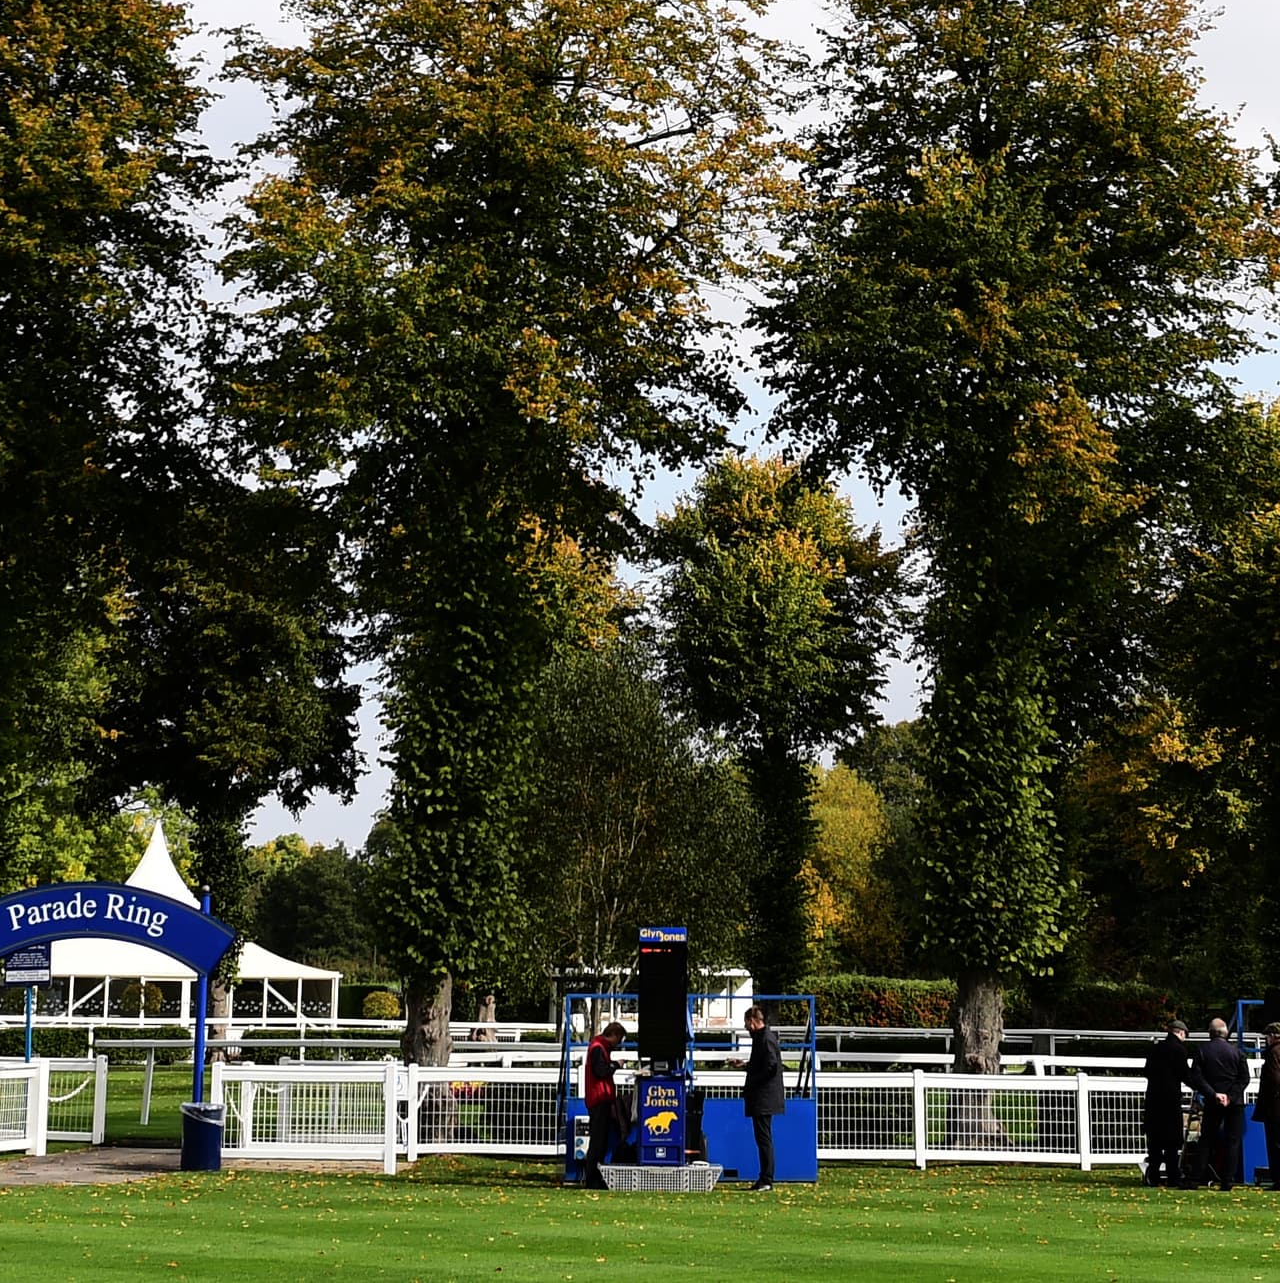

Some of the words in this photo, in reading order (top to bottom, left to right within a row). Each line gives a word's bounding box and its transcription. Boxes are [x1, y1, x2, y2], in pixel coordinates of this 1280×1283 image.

[6, 892, 97, 931] Parade
[103, 893, 169, 937] Ring
[640, 928, 663, 939] Glyn
[647, 1085, 676, 1098] Glyn
[643, 1096, 679, 1107] Jones
